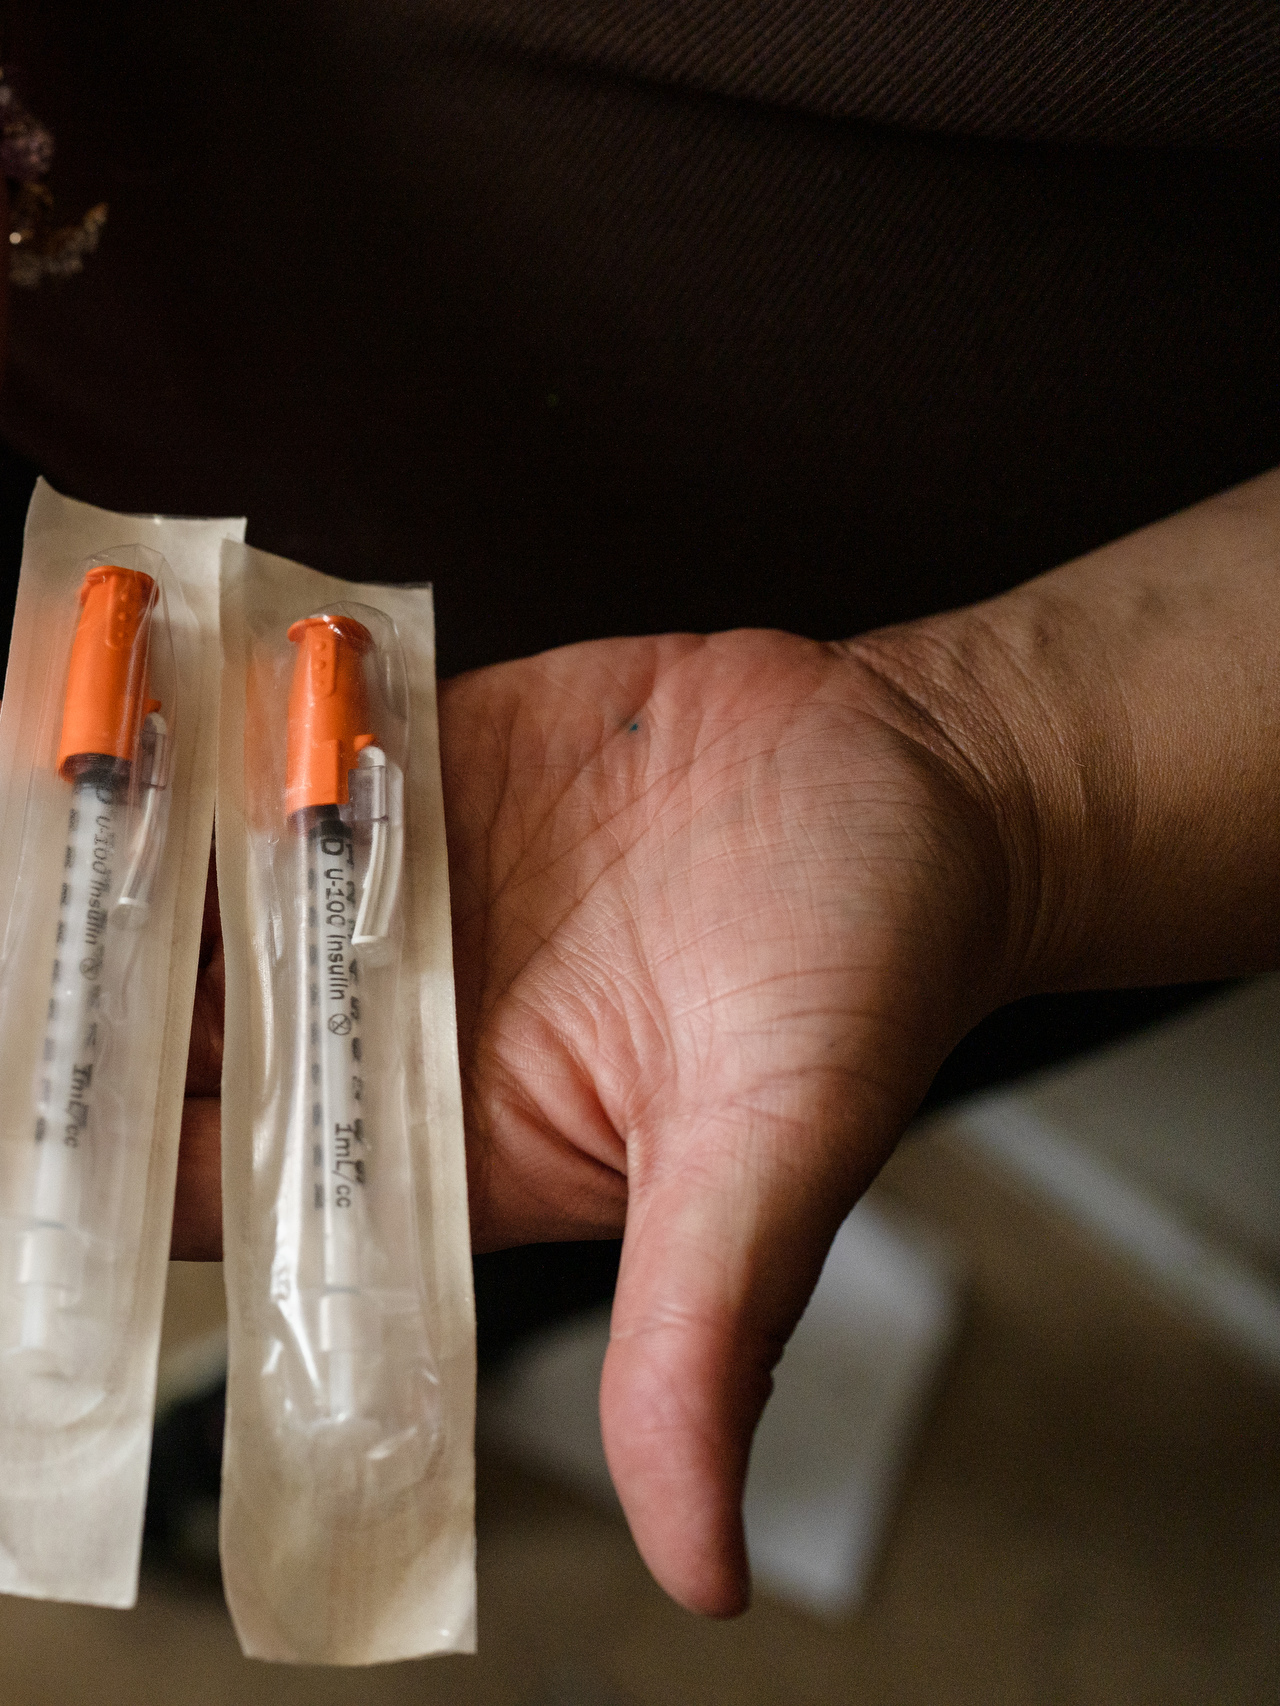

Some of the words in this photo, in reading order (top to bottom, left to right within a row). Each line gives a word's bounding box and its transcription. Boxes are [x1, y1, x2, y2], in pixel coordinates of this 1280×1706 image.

[91, 815, 111, 875] U-100
[84, 879, 104, 945] Insulin
[324, 868, 346, 926] U-100
[327, 934, 349, 1000] Insulin
[332, 1122, 358, 1208] 1mL/cc
